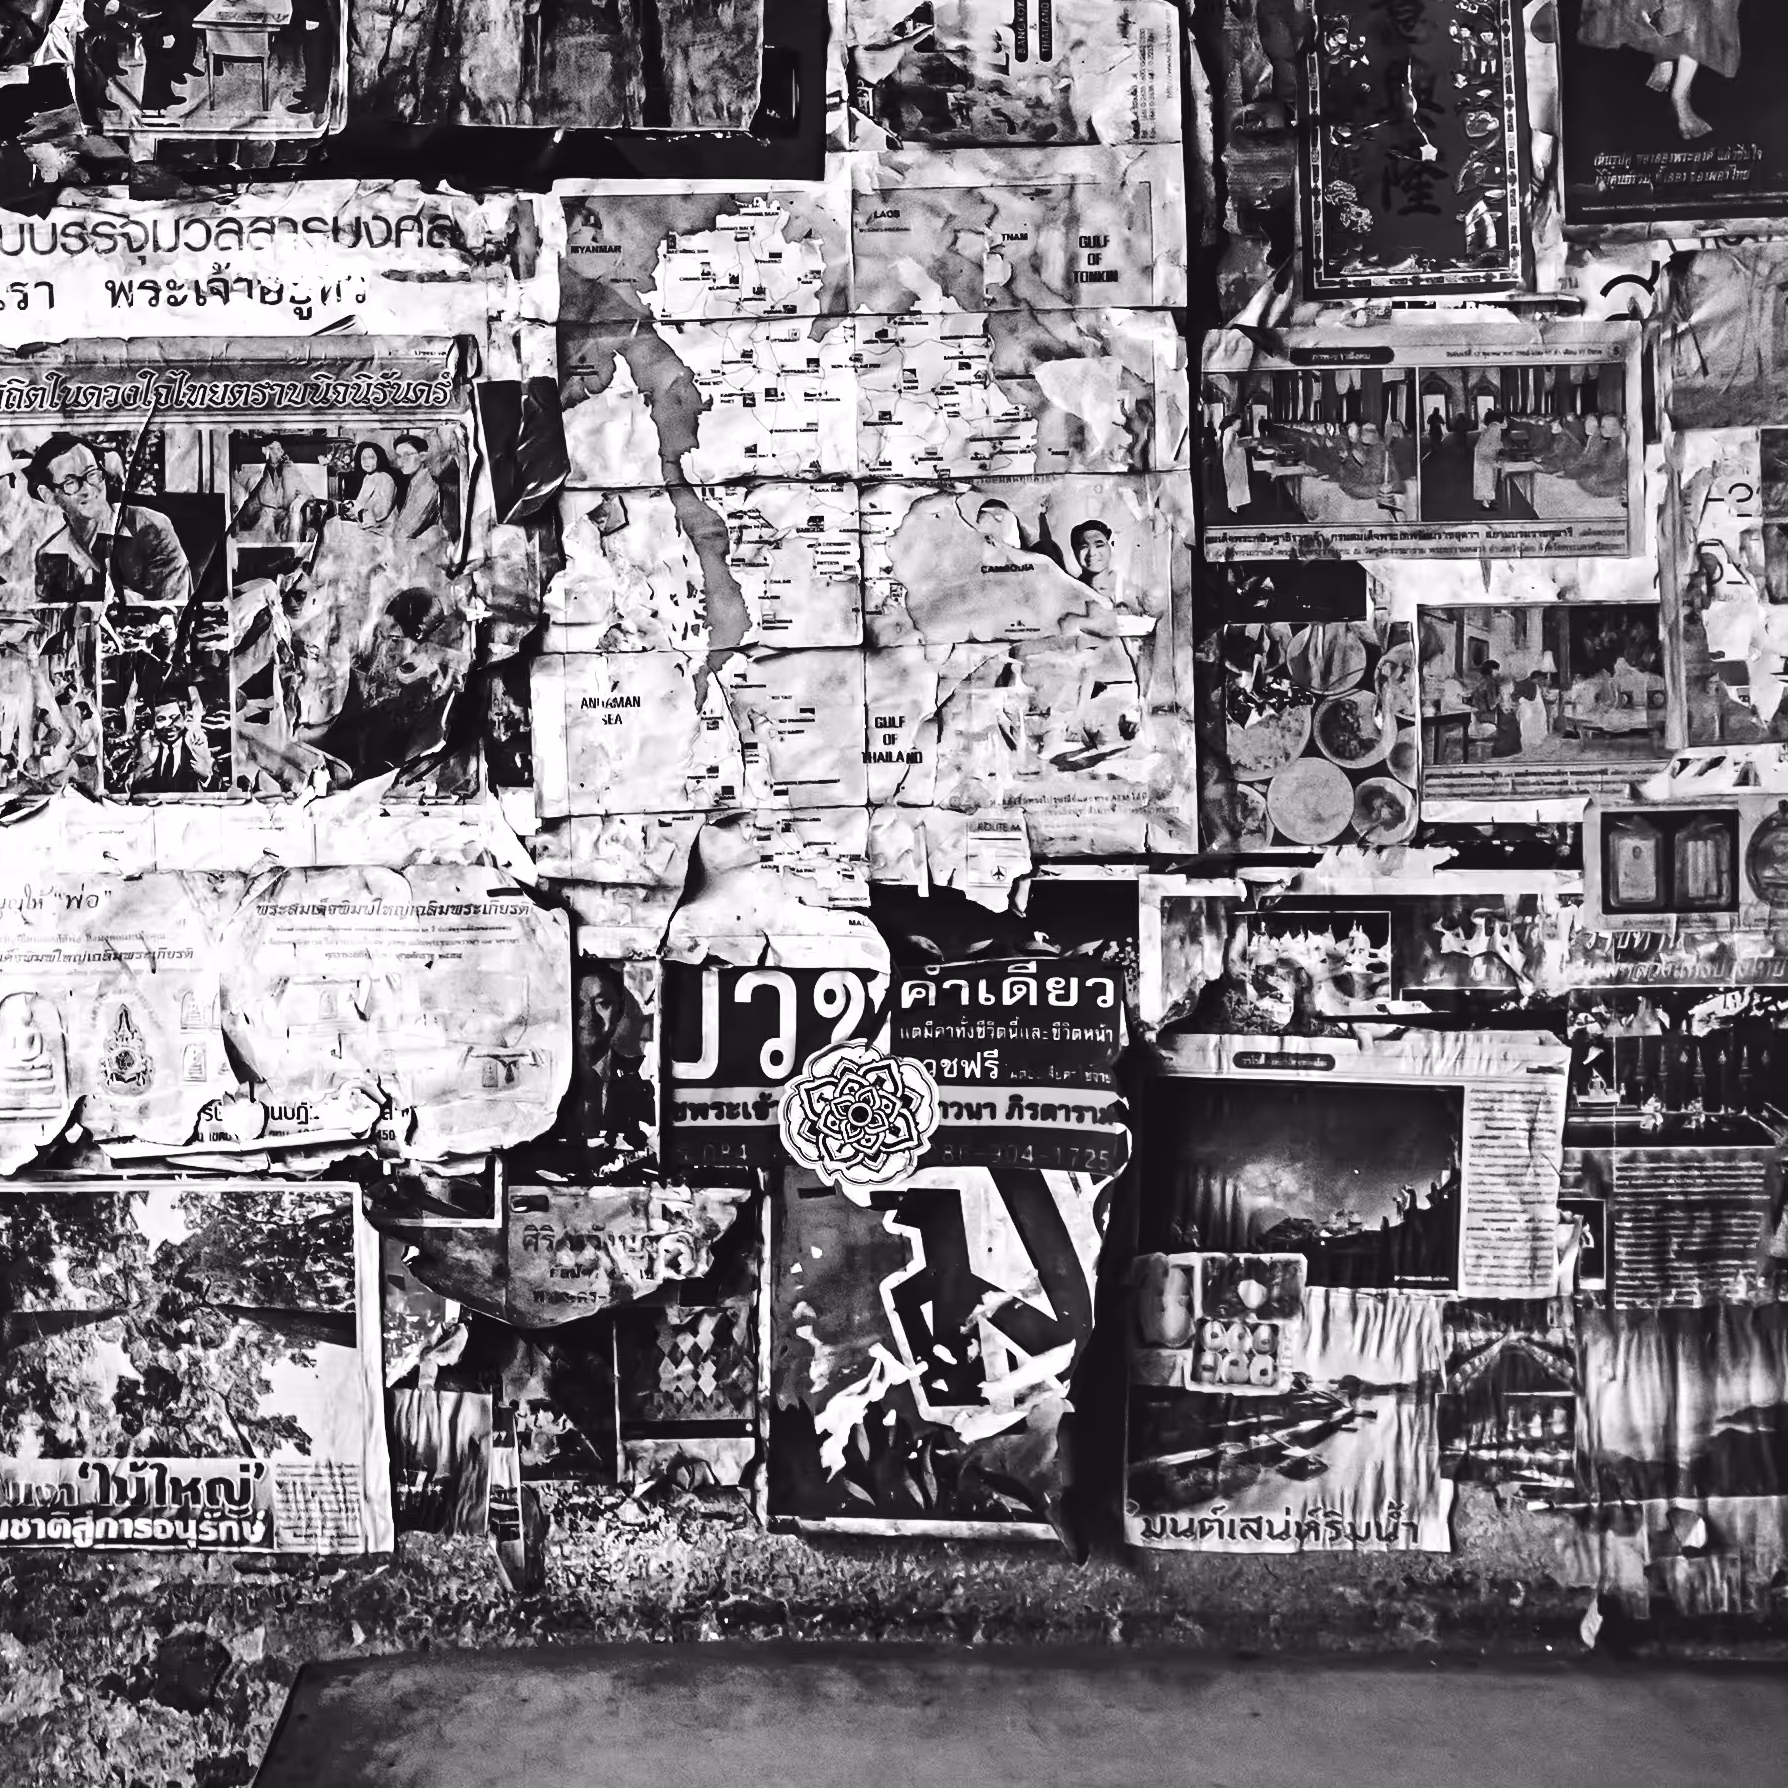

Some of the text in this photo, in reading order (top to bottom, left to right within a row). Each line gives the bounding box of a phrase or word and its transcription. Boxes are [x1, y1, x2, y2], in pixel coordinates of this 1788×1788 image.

[1078, 234, 1111, 249] GULF
[1088, 253, 1103, 266] OF
[873, 715, 906, 729] GULF
[883, 733, 899, 746] OF
[899, 961, 1116, 1010] คำเดียว
[923, 1049, 1000, 1081] วชฟรี
[1138, 1501, 1421, 1547] มนต์เสน่ห์ริมน้ำ
